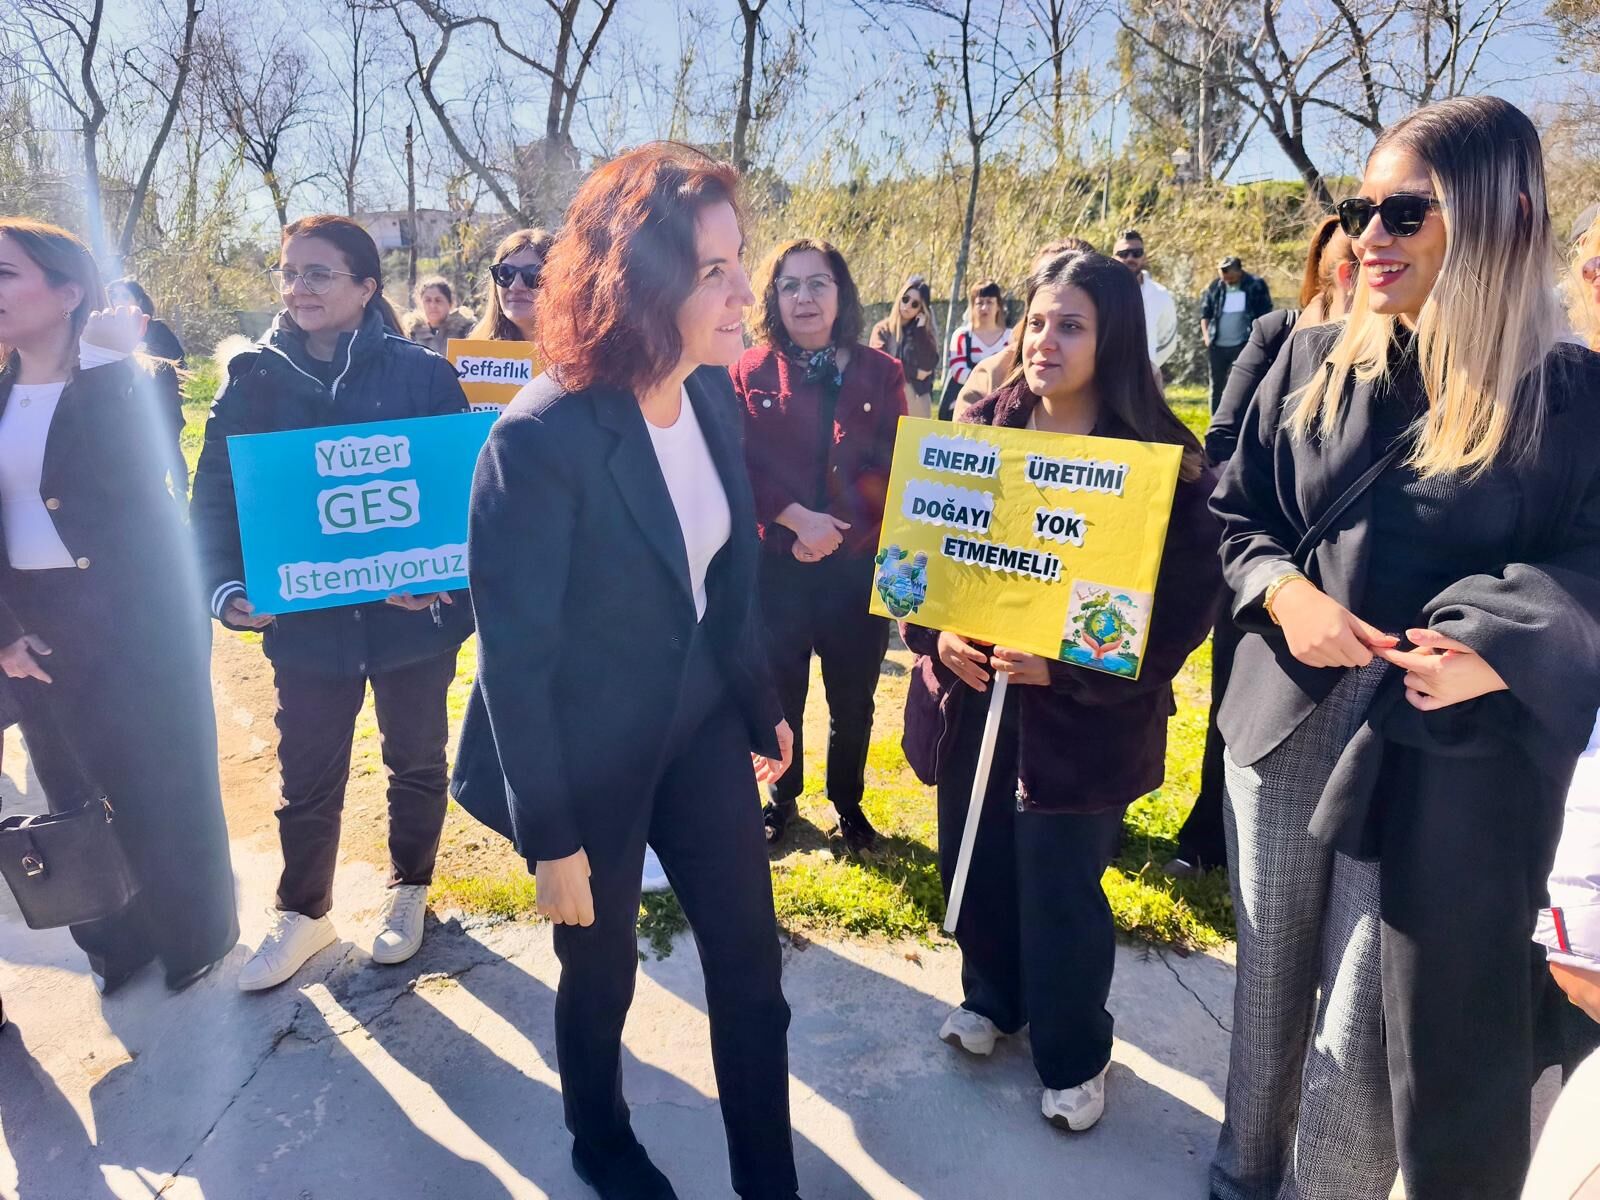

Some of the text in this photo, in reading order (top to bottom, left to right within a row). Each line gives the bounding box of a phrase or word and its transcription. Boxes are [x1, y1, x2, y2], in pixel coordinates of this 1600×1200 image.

[461, 360, 529, 379] Şeffaflık
[318, 441, 404, 470] Yüzer
[923, 447, 1124, 490] ENERJİ ÜRETİMİ
[324, 485, 413, 529] GES
[912, 497, 1081, 538] DOĞAYI YOK
[285, 553, 465, 596] İstemiyoruz
[943, 538, 1059, 578] ETMEMELİ!
